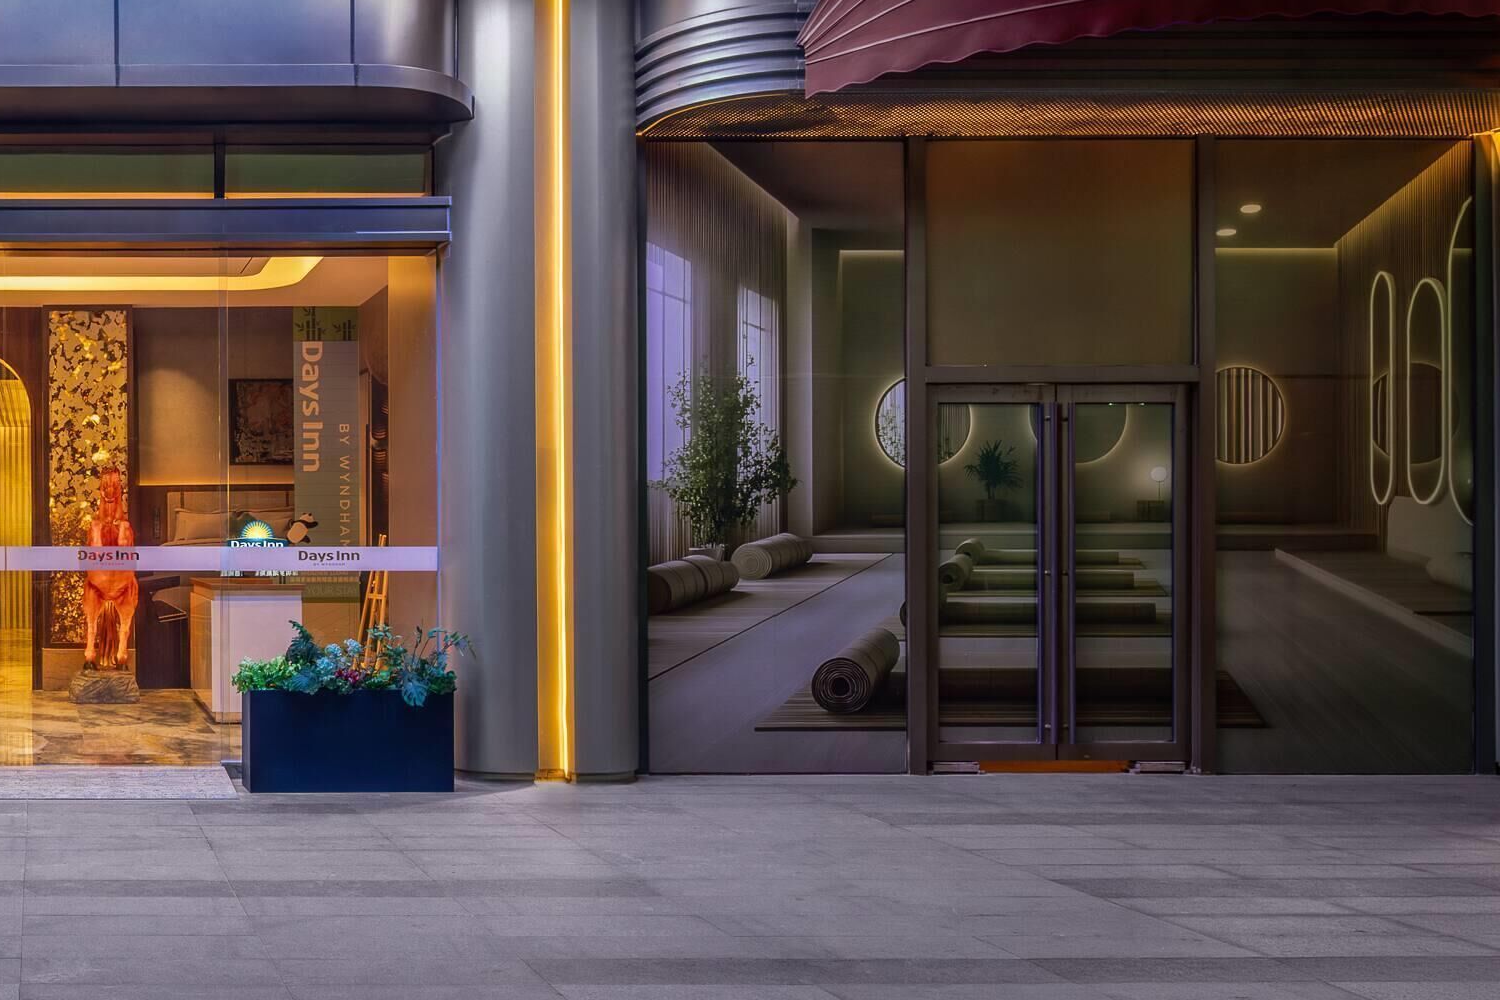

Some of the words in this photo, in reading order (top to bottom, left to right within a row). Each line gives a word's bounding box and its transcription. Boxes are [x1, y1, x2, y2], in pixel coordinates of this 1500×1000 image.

[299, 341, 324, 417] Days
[338, 423, 350, 446] BY
[302, 422, 324, 473] Inn
[78, 550, 113, 562] Days
[116, 550, 140, 561] Inn
[298, 550, 334, 562] Days
[336, 550, 360, 561] Inn
